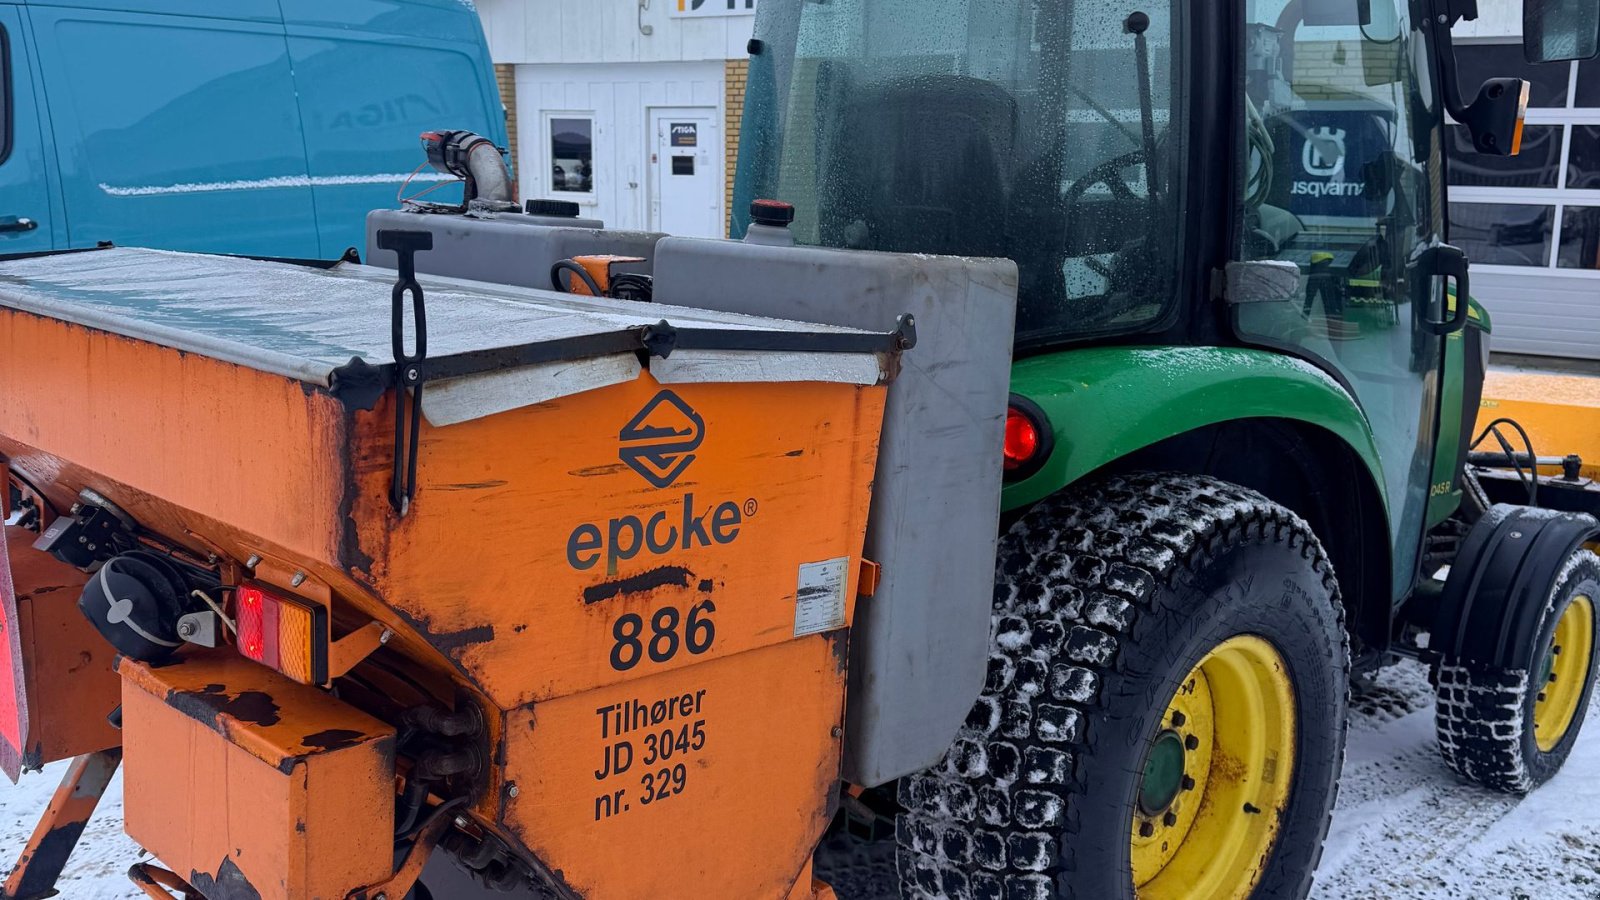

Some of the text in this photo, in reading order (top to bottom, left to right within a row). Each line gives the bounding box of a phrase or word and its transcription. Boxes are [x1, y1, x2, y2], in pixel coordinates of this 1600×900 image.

[671, 125, 696, 134] STIGA
[1290, 181, 1366, 198] usqvarn
[1431, 481, 1450, 497] 045R
[609, 600, 716, 671] 886
[596, 689, 706, 739] Tilhører
[595, 720, 705, 780] JD 3045
[595, 763, 687, 821] nr. 329
